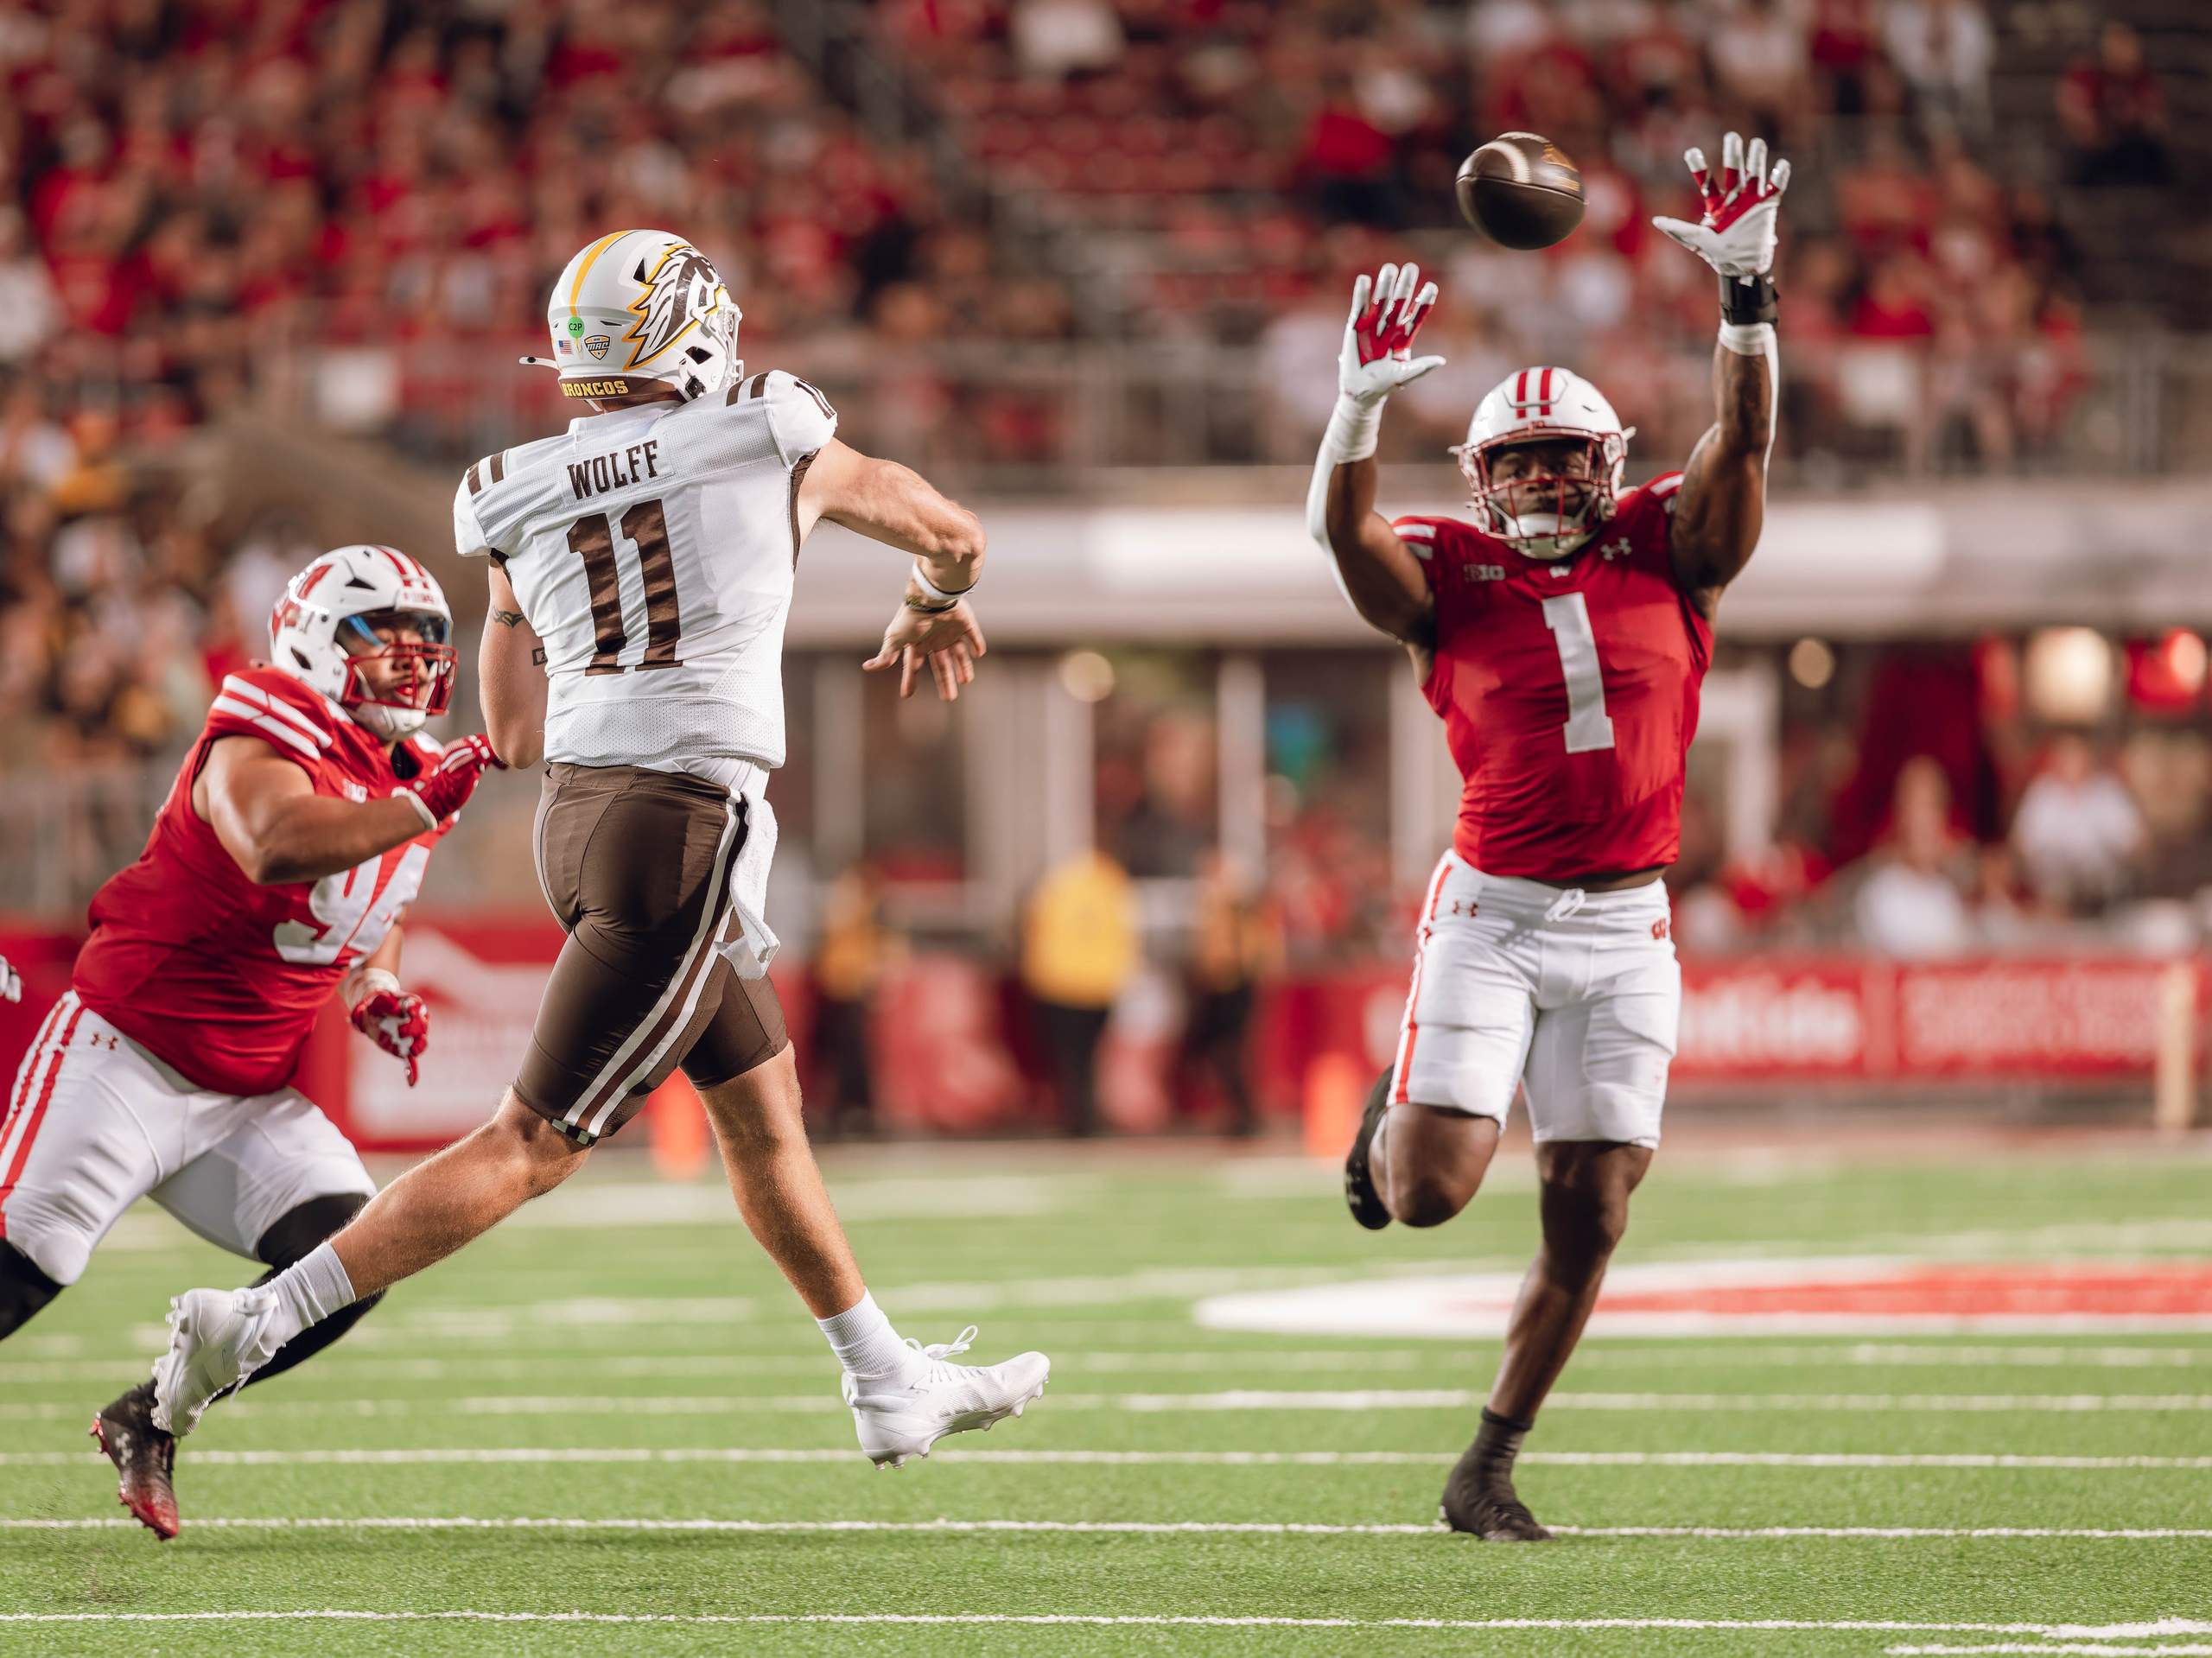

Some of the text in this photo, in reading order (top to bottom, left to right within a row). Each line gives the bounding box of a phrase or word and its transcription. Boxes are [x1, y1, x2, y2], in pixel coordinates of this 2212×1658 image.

[587, 342, 609, 351] MAC
[562, 380, 629, 397] BRONCOS
[567, 439, 658, 500] WOLFF
[567, 499, 683, 677] 11
[1542, 592, 1615, 754] 1
